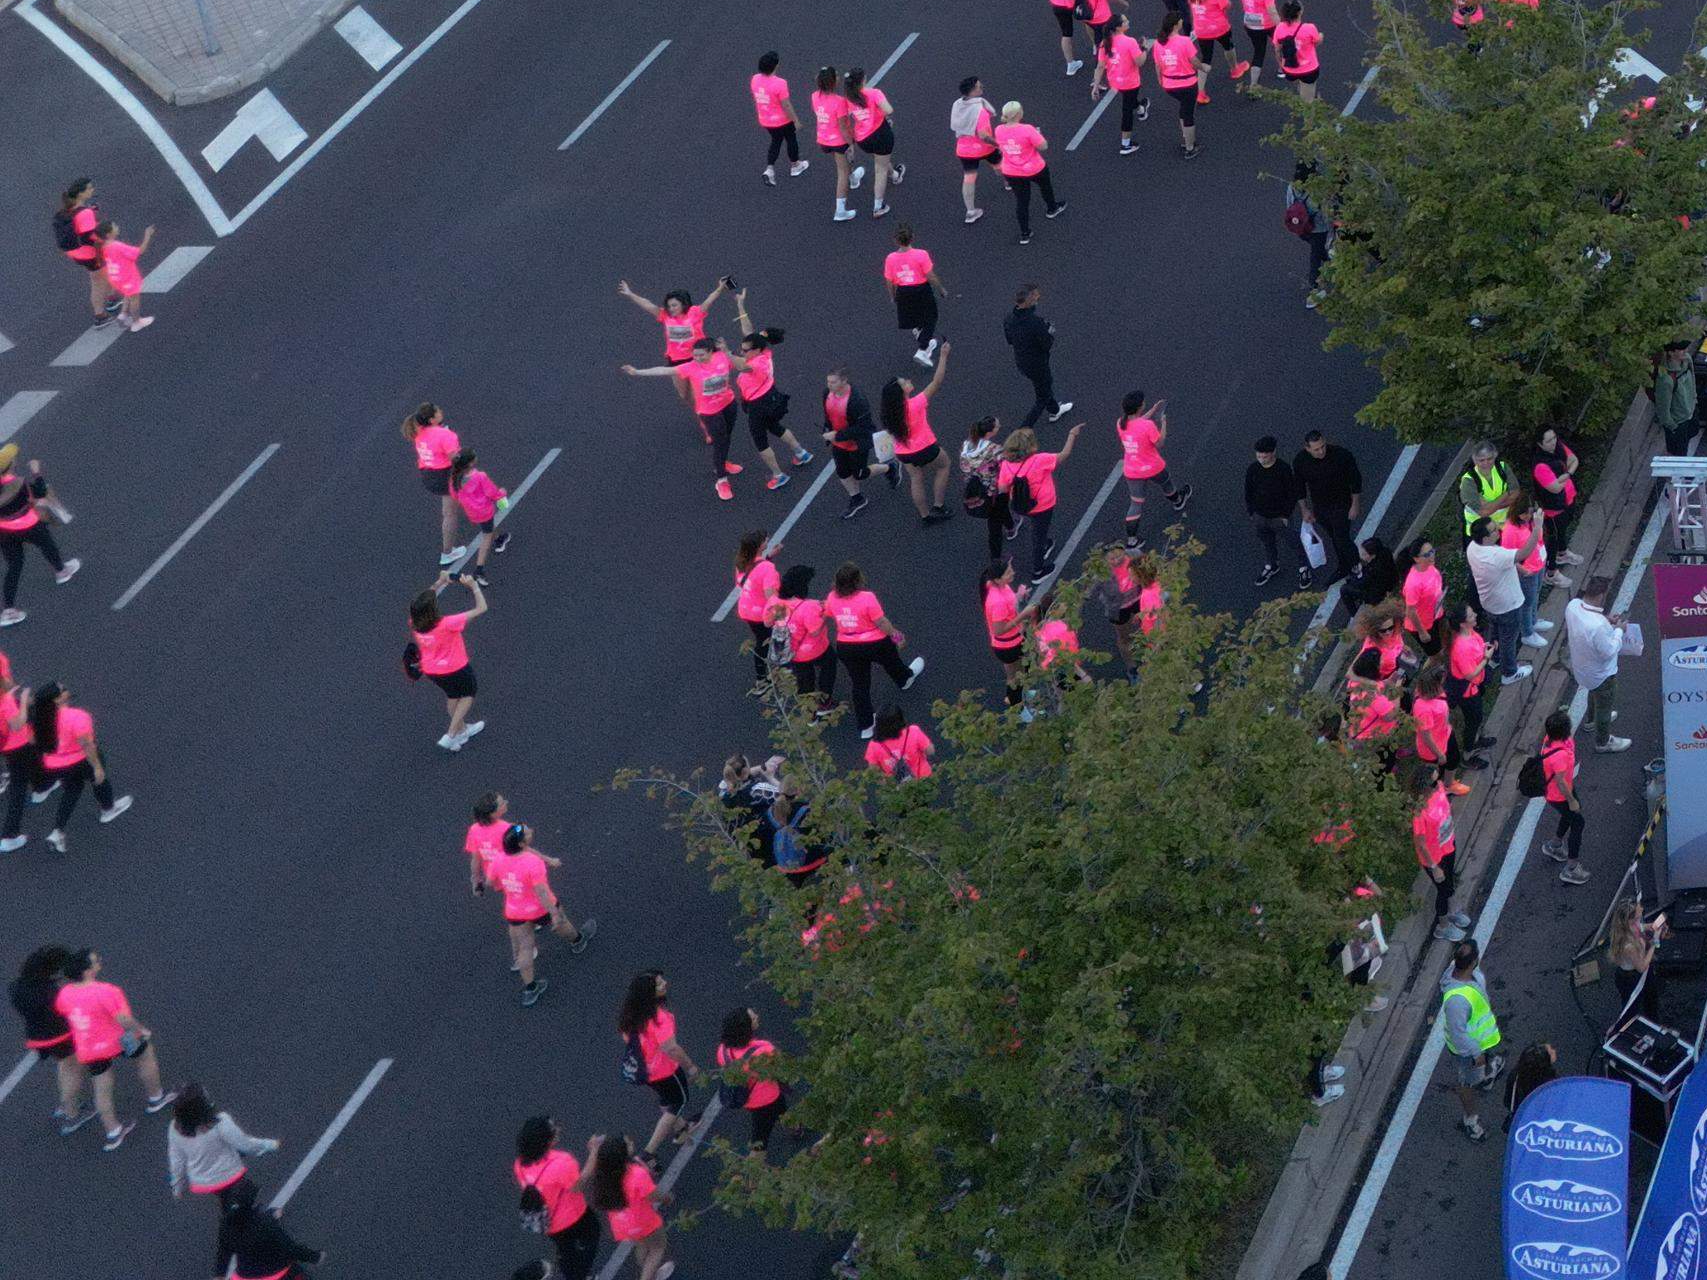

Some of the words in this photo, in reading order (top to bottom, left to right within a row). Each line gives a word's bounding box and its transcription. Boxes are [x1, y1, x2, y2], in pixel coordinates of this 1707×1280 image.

[1525, 1127, 1615, 1154] ASTURIANA
[1521, 1188, 1613, 1213] ASTURIANA
[1519, 1251, 1611, 1275] ASTURIANA
